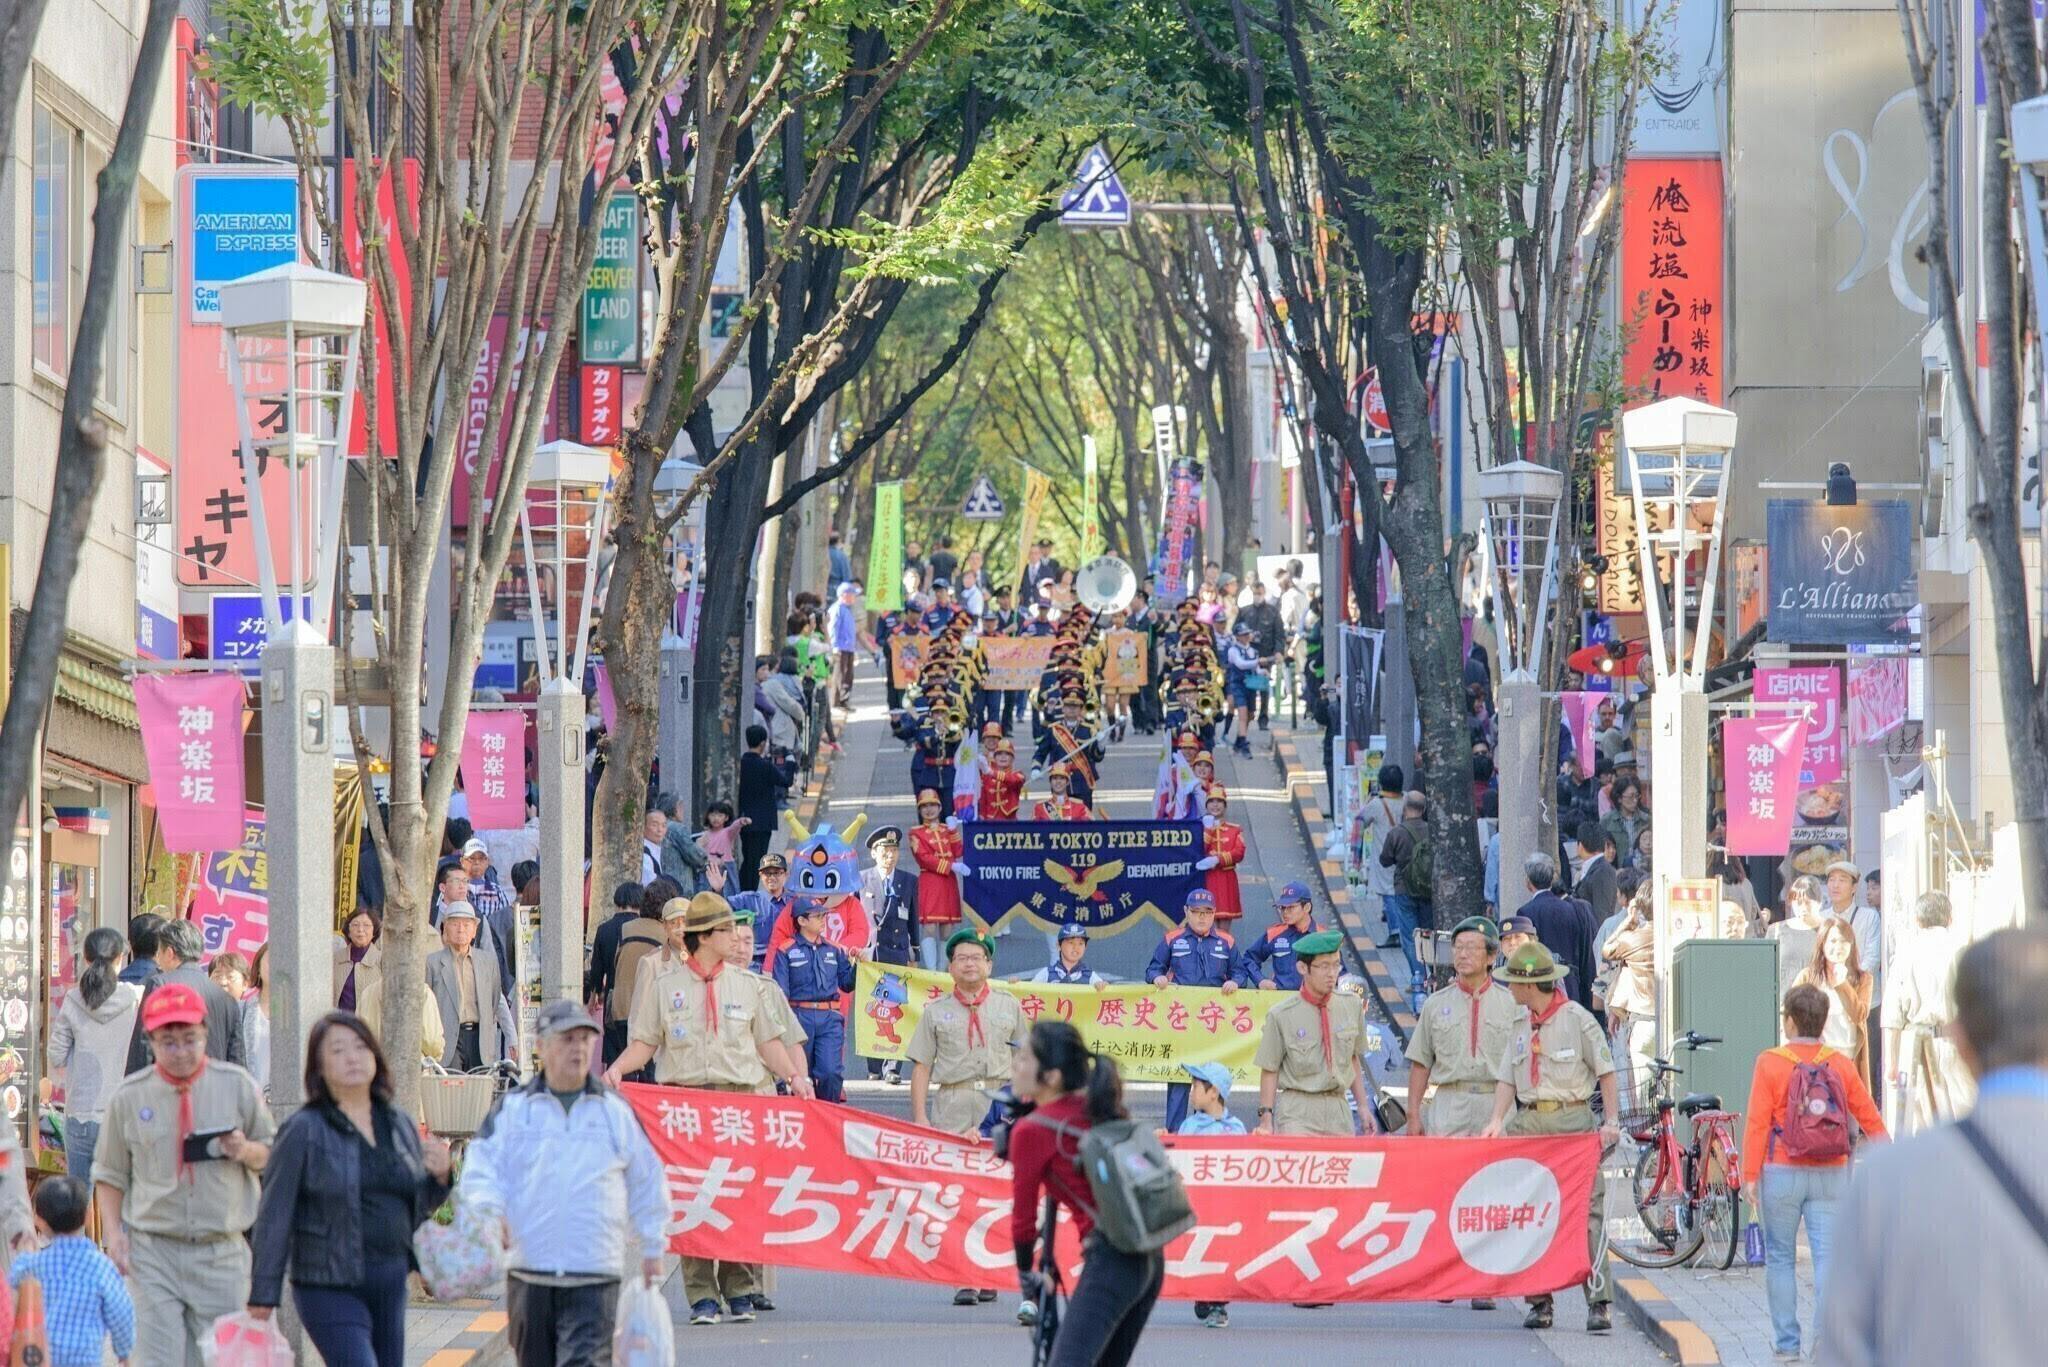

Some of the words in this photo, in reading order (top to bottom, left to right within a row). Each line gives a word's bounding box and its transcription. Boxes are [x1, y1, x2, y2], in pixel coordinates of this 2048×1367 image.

[1645, 119, 1700, 130] ENTRAIDE
[195, 214, 291, 230] AMERICAN
[602, 207, 633, 229] RAFT
[216, 234, 296, 251] EXPRESS
[595, 237, 628, 259] BEER
[587, 267, 634, 289] SERVER
[195, 286, 219, 299] Car
[195, 301, 221, 311] Wel
[591, 297, 630, 320] LAND
[594, 340, 620, 351] B1F
[591, 368, 610, 442] カラオケ
[1777, 582, 1892, 610] L'Allian
[224, 640, 269, 657] コンタ
[1767, 673, 1831, 696] 店内に
[178, 705, 215, 804] 神楽坂
[482, 733, 506, 799] 神楽坂
[1746, 744, 1776, 819] 神楽坂
[974, 833, 1044, 850] CAPITAL
[1050, 832, 1102, 849] TOKYO
[1107, 831, 1148, 849] FIRE
[1151, 830, 1193, 848] BIRD
[978, 866, 1013, 880] TOKYO
[1015, 866, 1041, 880] FIRE
[1127, 862, 1192, 879] DEPARTMENT
[1070, 853, 1097, 868] 119
[1030, 891, 1134, 921] 東京消防庁
[1096, 996, 1254, 1034] 歴史を守る
[1091, 1039, 1174, 1059] 牛込消防署
[658, 1100, 807, 1151] 神楽坂
[1193, 1154, 1352, 1185] まちの文化祭
[1457, 1201, 1552, 1233] 開催中!
